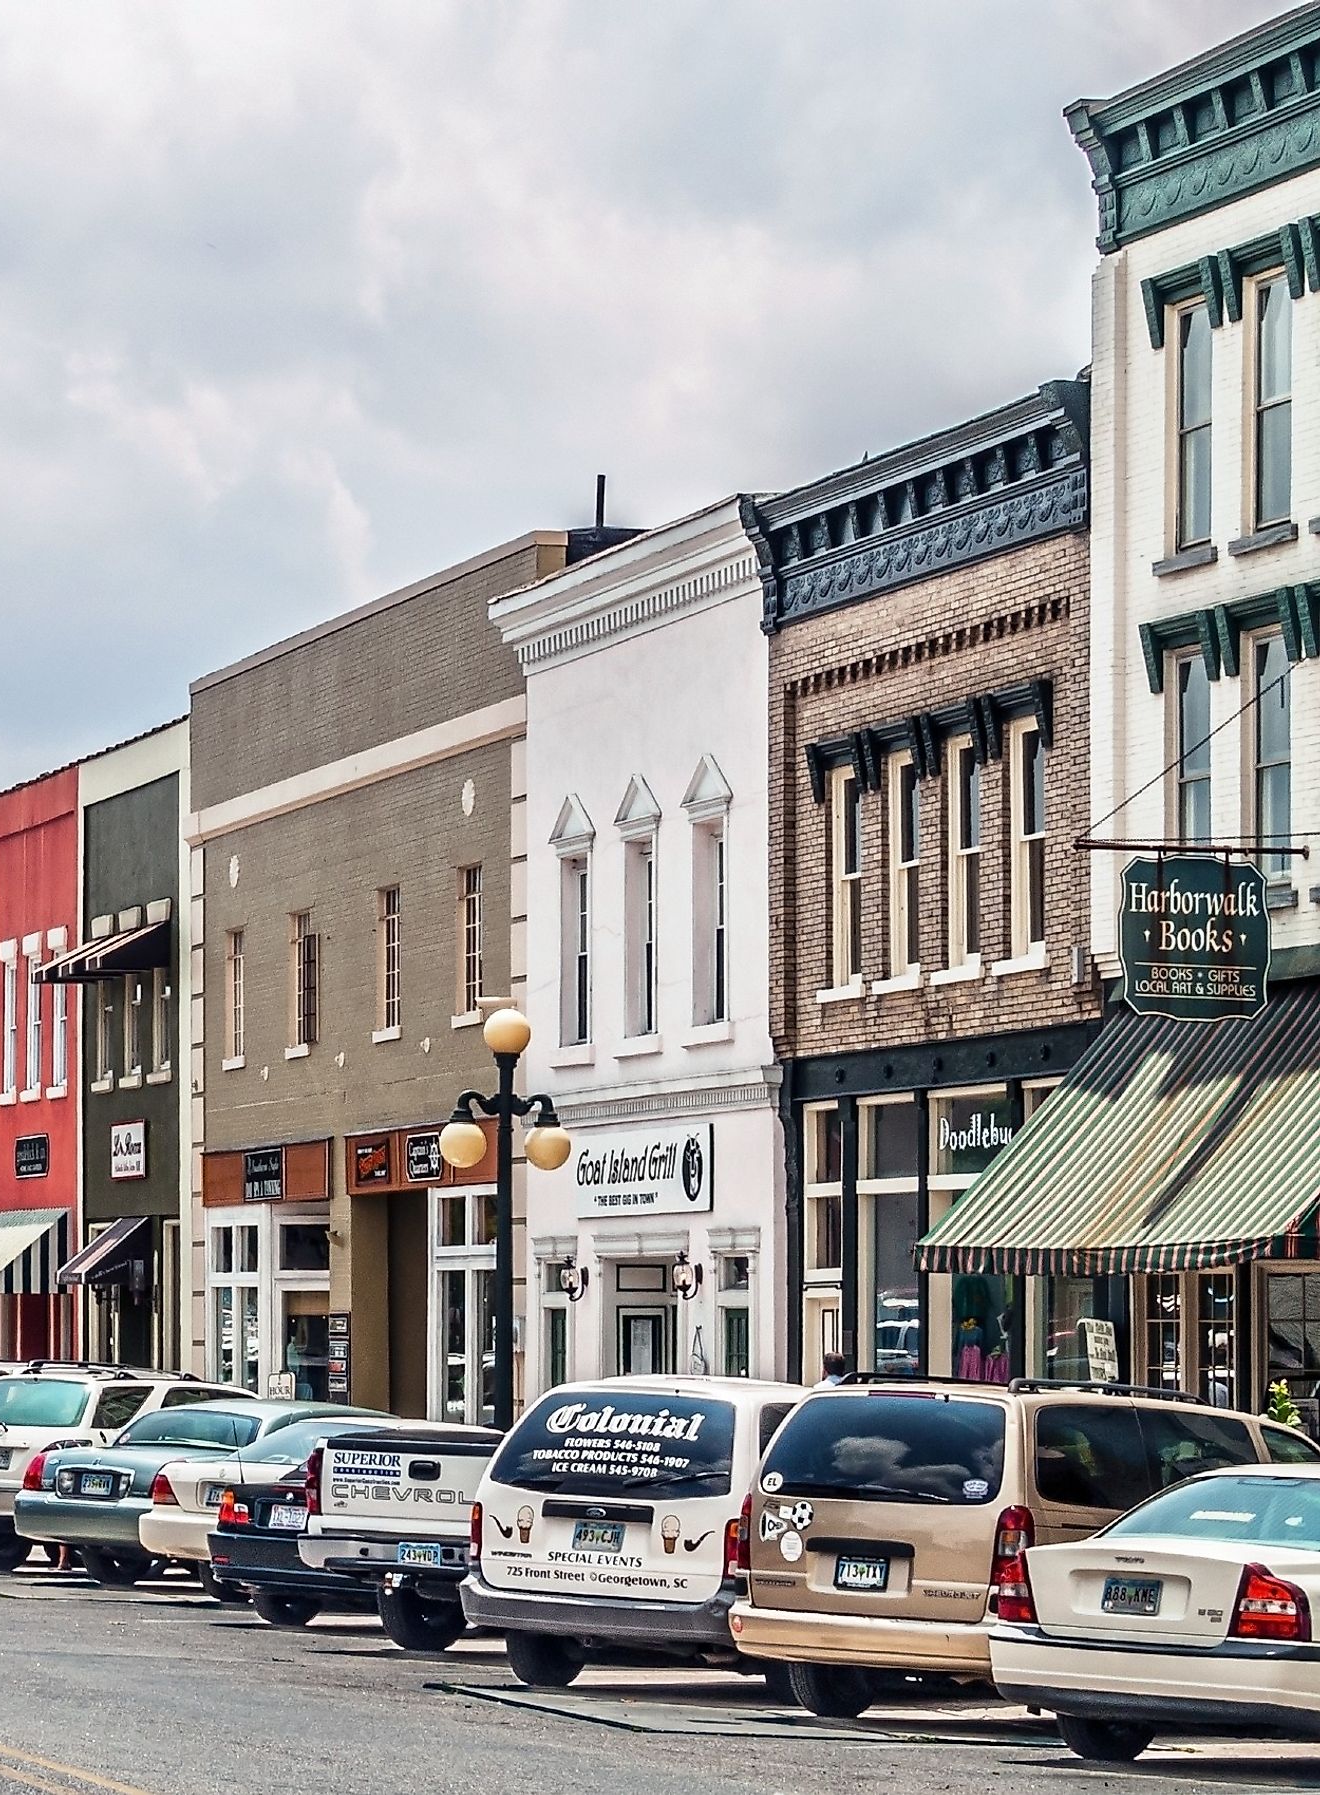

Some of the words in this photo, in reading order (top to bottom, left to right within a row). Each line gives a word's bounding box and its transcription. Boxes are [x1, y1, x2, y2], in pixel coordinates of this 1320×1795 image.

[1130, 879, 1260, 917] Harborwalk
[1159, 918, 1233, 952] Books
[1151, 967, 1193, 980] BOOKS
[1208, 969, 1240, 983] GIFTS
[1135, 980, 1168, 993] LOCAL
[1172, 981, 1194, 994] ART
[1195, 981, 1205, 995] &
[1207, 983, 1256, 997] SUPPLIES
[577, 1149, 608, 1186] Goat
[607, 1145, 648, 1184] Island
[648, 1142, 678, 1180] Grill
[609, 1194, 621, 1206] BEST
[632, 1193, 638, 1204] IN
[270, 1386, 291, 1396] HOUR
[546, 1403, 706, 1442] Colonial
[564, 1438, 611, 1449] FLOWERS
[613, 1439, 661, 1452] 546-5108
[333, 1452, 401, 1467] SUPERIOR
[532, 1450, 580, 1460] TOBACCO
[581, 1450, 638, 1463] PRODUCTS
[640, 1454, 690, 1469] 546-1907
[334, 1467, 400, 1476] CONSTRUCTION
[552, 1462, 569, 1473] ICE
[570, 1463, 607, 1474] CREAM
[608, 1465, 658, 1478] 545-9708
[576, 1530, 594, 1542] 493
[400, 1549, 416, 1560] 243
[548, 1551, 593, 1564] SPECIAL
[597, 1554, 643, 1568] EVENTS
[507, 1566, 522, 1576] 725
[525, 1568, 550, 1578] Front
[554, 1570, 585, 1581] Street
[598, 1574, 670, 1588] Georgetown,
[674, 1578, 688, 1589] SC
[839, 1562, 858, 1577] 713
[1105, 1587, 1127, 1601] 888
